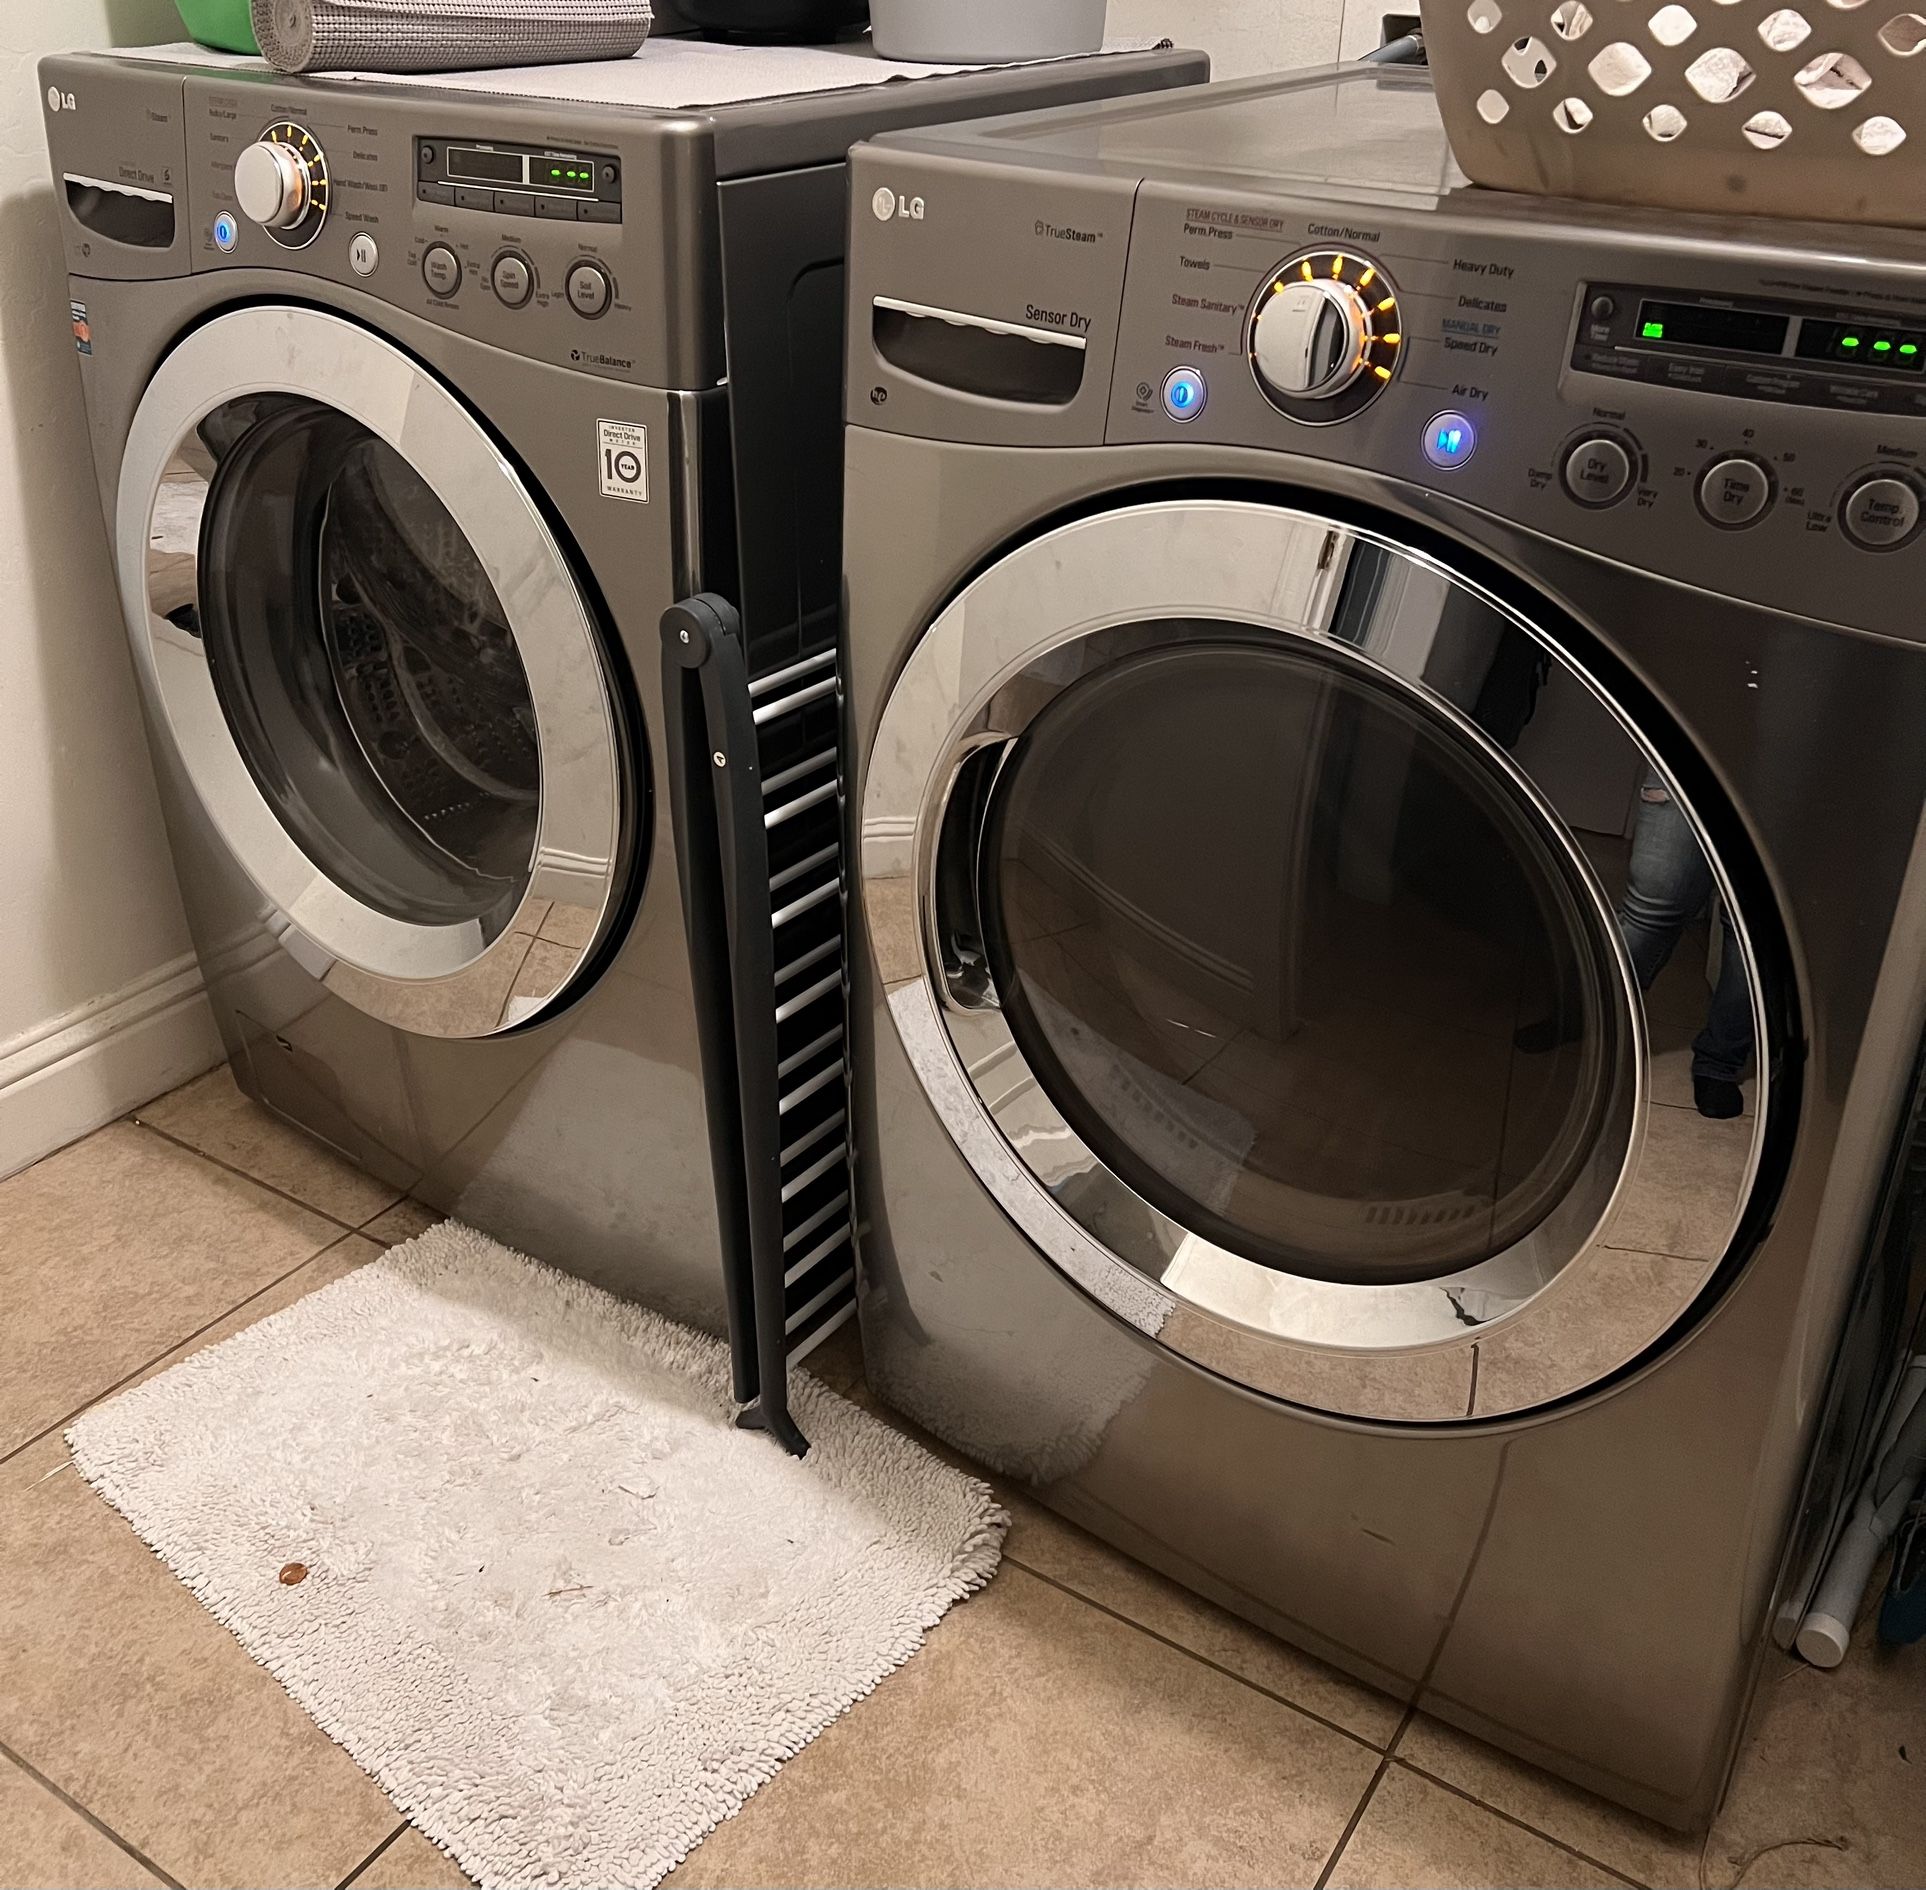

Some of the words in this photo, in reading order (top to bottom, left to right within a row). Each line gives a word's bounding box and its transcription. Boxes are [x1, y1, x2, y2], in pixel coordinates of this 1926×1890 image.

[61, 90, 76, 111] LG
[899, 195, 925, 220] LG
[1186, 208, 1210, 220] STEAM
[1211, 211, 1232, 223] CYCLE
[1240, 215, 1268, 228] SENSOR
[1269, 218, 1284, 230] DRY
[1208, 225, 1233, 240] Press
[1308, 223, 1381, 243] Cotton/Normal
[1180, 256, 1210, 271] Towels
[1453, 258, 1487, 276] Heavy
[1488, 263, 1515, 280] Duty
[579, 280, 592, 291] Soil
[577, 289, 595, 300] Level
[1171, 294, 1200, 309] Steam
[1458, 295, 1507, 313] Delicates
[1025, 304, 1068, 326] Sensor
[1069, 312, 1092, 333] Dry
[1442, 318, 1480, 333] MANUAL
[1482, 323, 1501, 335] DRY
[1164, 335, 1192, 350] Steam
[1444, 337, 1478, 353] Speed
[1479, 342, 1498, 357] Dry
[1452, 384, 1468, 396] Air
[1469, 387, 1489, 401] Dry
[1593, 407, 1626, 421] Normal
[603, 429, 623, 440] Direct
[623, 433, 641, 442] Drive
[1877, 444, 1918, 458] Medium
[605, 449, 641, 483] 10
[1588, 458, 1607, 473] Dry
[1580, 469, 1610, 484] Level
[607, 486, 642, 496] WARRANTY
[1725, 478, 1750, 493] Time
[1724, 490, 1744, 505] Dry
[1806, 521, 1828, 532] Low
[1860, 511, 1905, 527] Control
